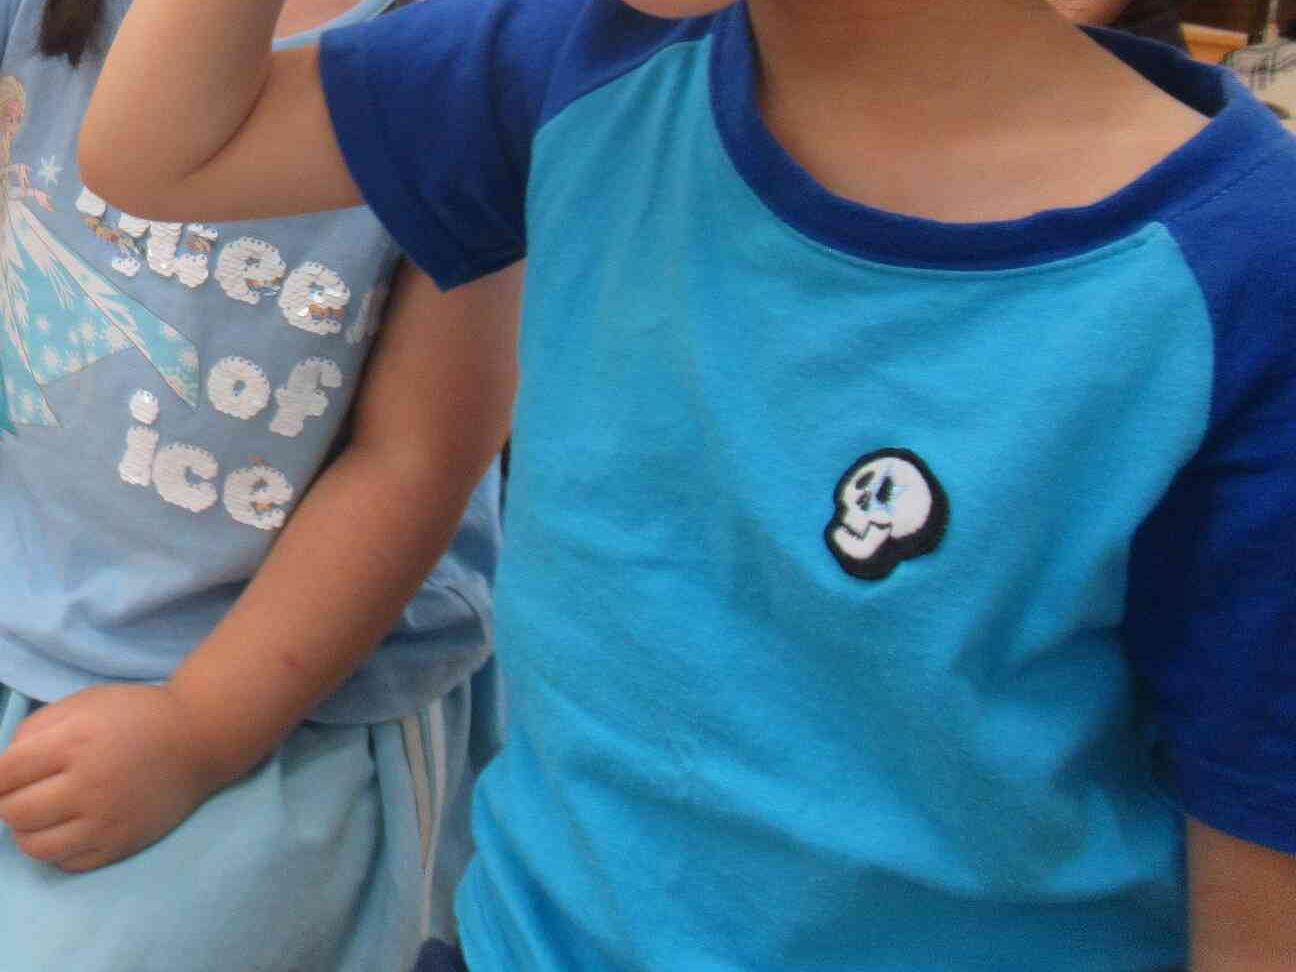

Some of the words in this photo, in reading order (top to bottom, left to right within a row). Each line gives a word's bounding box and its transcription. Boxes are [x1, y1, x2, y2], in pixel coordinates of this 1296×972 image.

[75, 186, 378, 345] uee
[117, 389, 294, 530] ice
[207, 356, 343, 437] of
